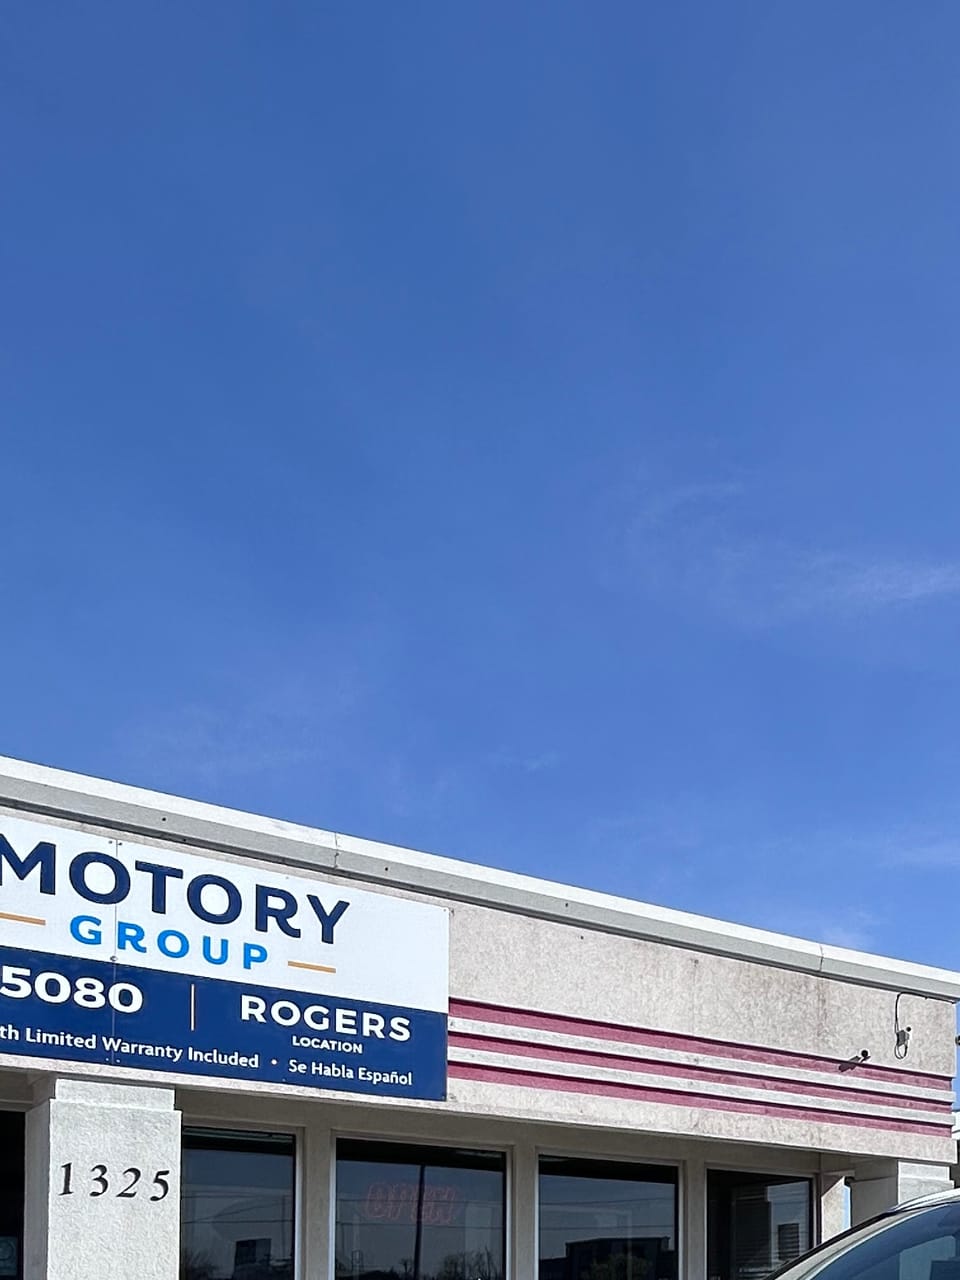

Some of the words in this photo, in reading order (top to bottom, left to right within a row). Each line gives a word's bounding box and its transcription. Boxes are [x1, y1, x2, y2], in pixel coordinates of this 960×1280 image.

[0, 833, 350, 944] MOTORY
[70, 916, 268, 969] GROUP
[241, 994, 411, 1042] ROGERS
[25, 1027, 97, 1049] Limited
[102, 1036, 183, 1063] Warranty
[188, 1046, 259, 1068] Included
[288, 1059, 307, 1074] Se
[311, 1061, 354, 1079] Habla
[358, 1067, 412, 1086] Español
[292, 1035, 363, 1054] LOCATION
[58, 1162, 170, 1202] 1325
